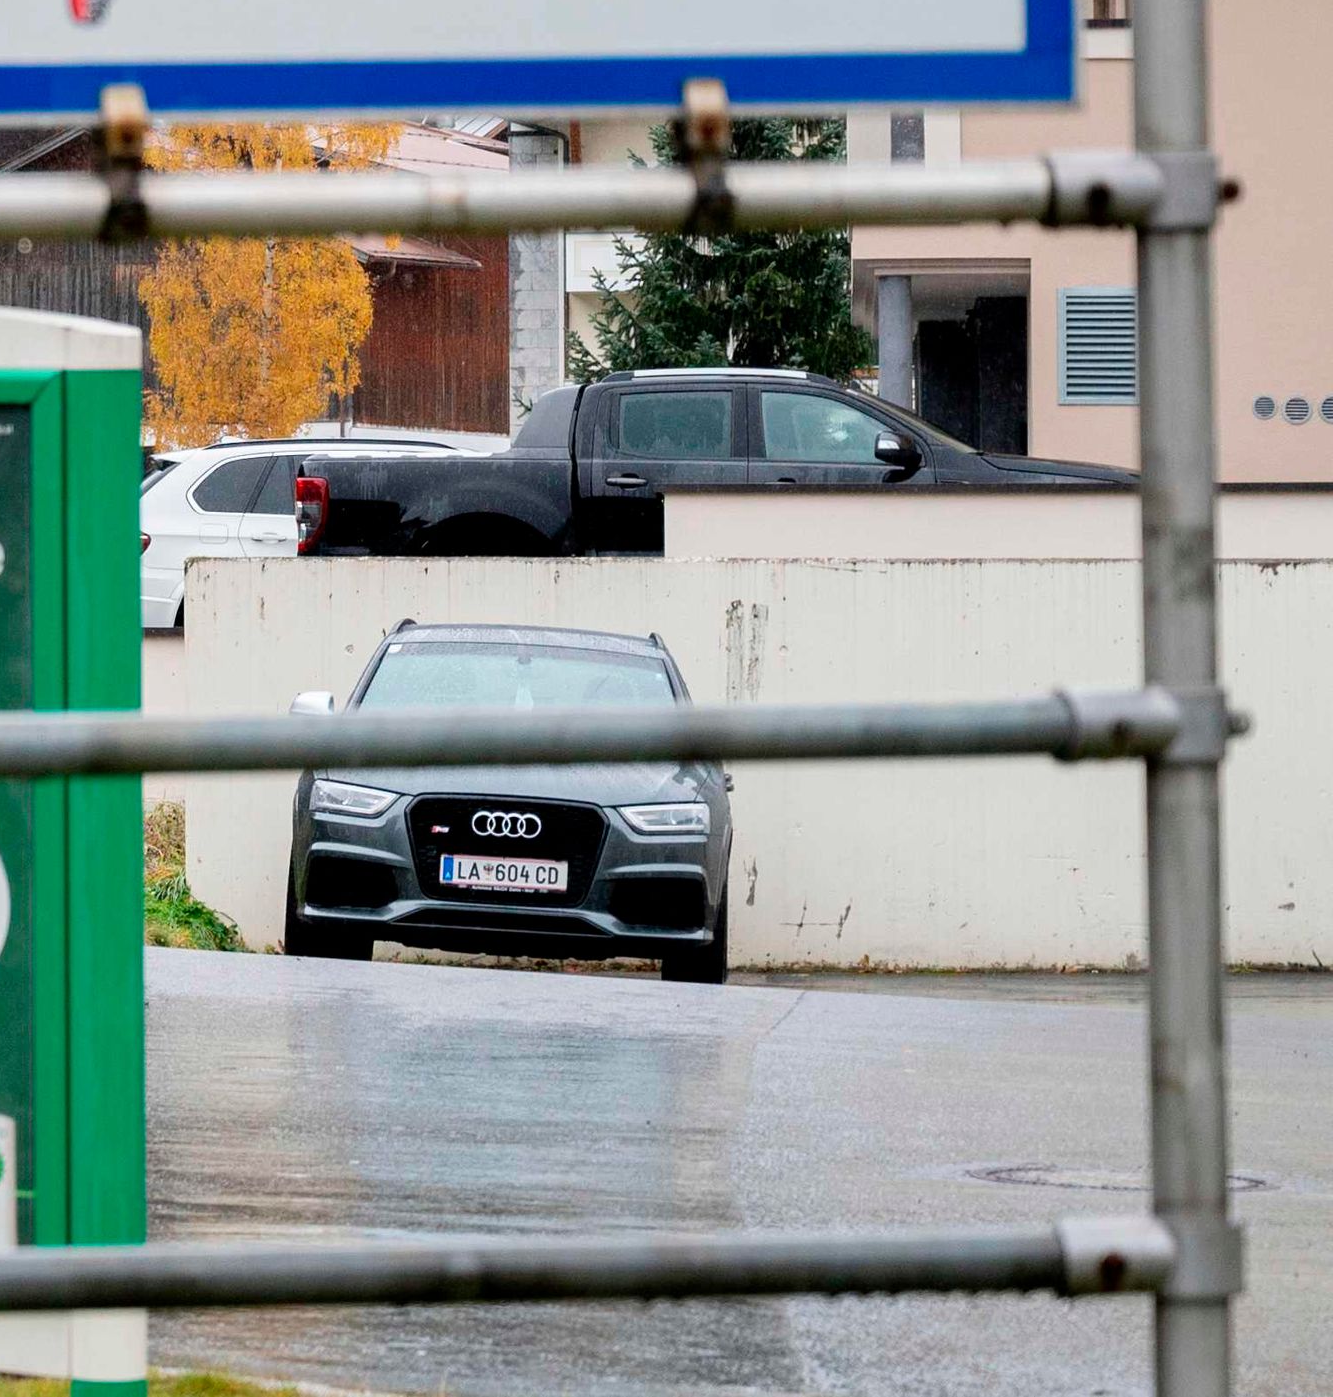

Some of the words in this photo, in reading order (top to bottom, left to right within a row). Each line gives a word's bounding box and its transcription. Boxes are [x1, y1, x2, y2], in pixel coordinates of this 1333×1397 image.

[457, 861, 480, 880] LA
[495, 863, 530, 883] 604
[535, 865, 559, 885] CD
